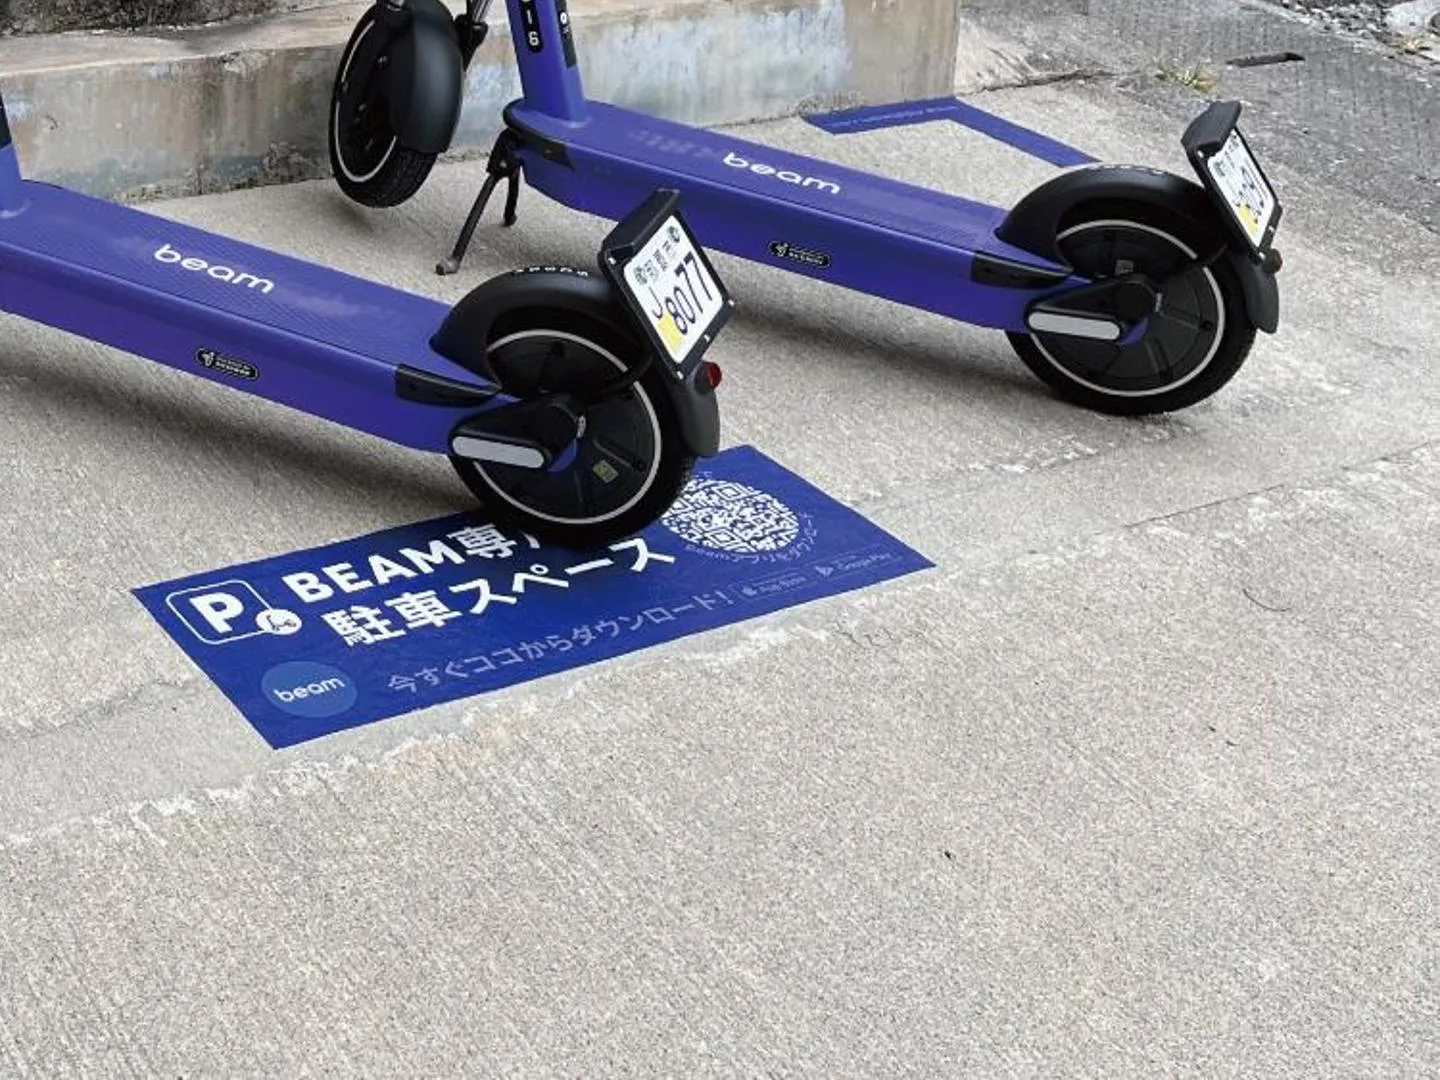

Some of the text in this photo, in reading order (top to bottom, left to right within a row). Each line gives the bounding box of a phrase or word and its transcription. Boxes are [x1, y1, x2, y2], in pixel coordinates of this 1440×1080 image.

[723, 152, 841, 194] beam
[154, 243, 275, 294] beam
[665, 251, 713, 336] 8077
[281, 523, 540, 603] BEAM専
[189, 591, 245, 634] P
[320, 537, 676, 647] 駐車スペース
[273, 677, 346, 703] beam
